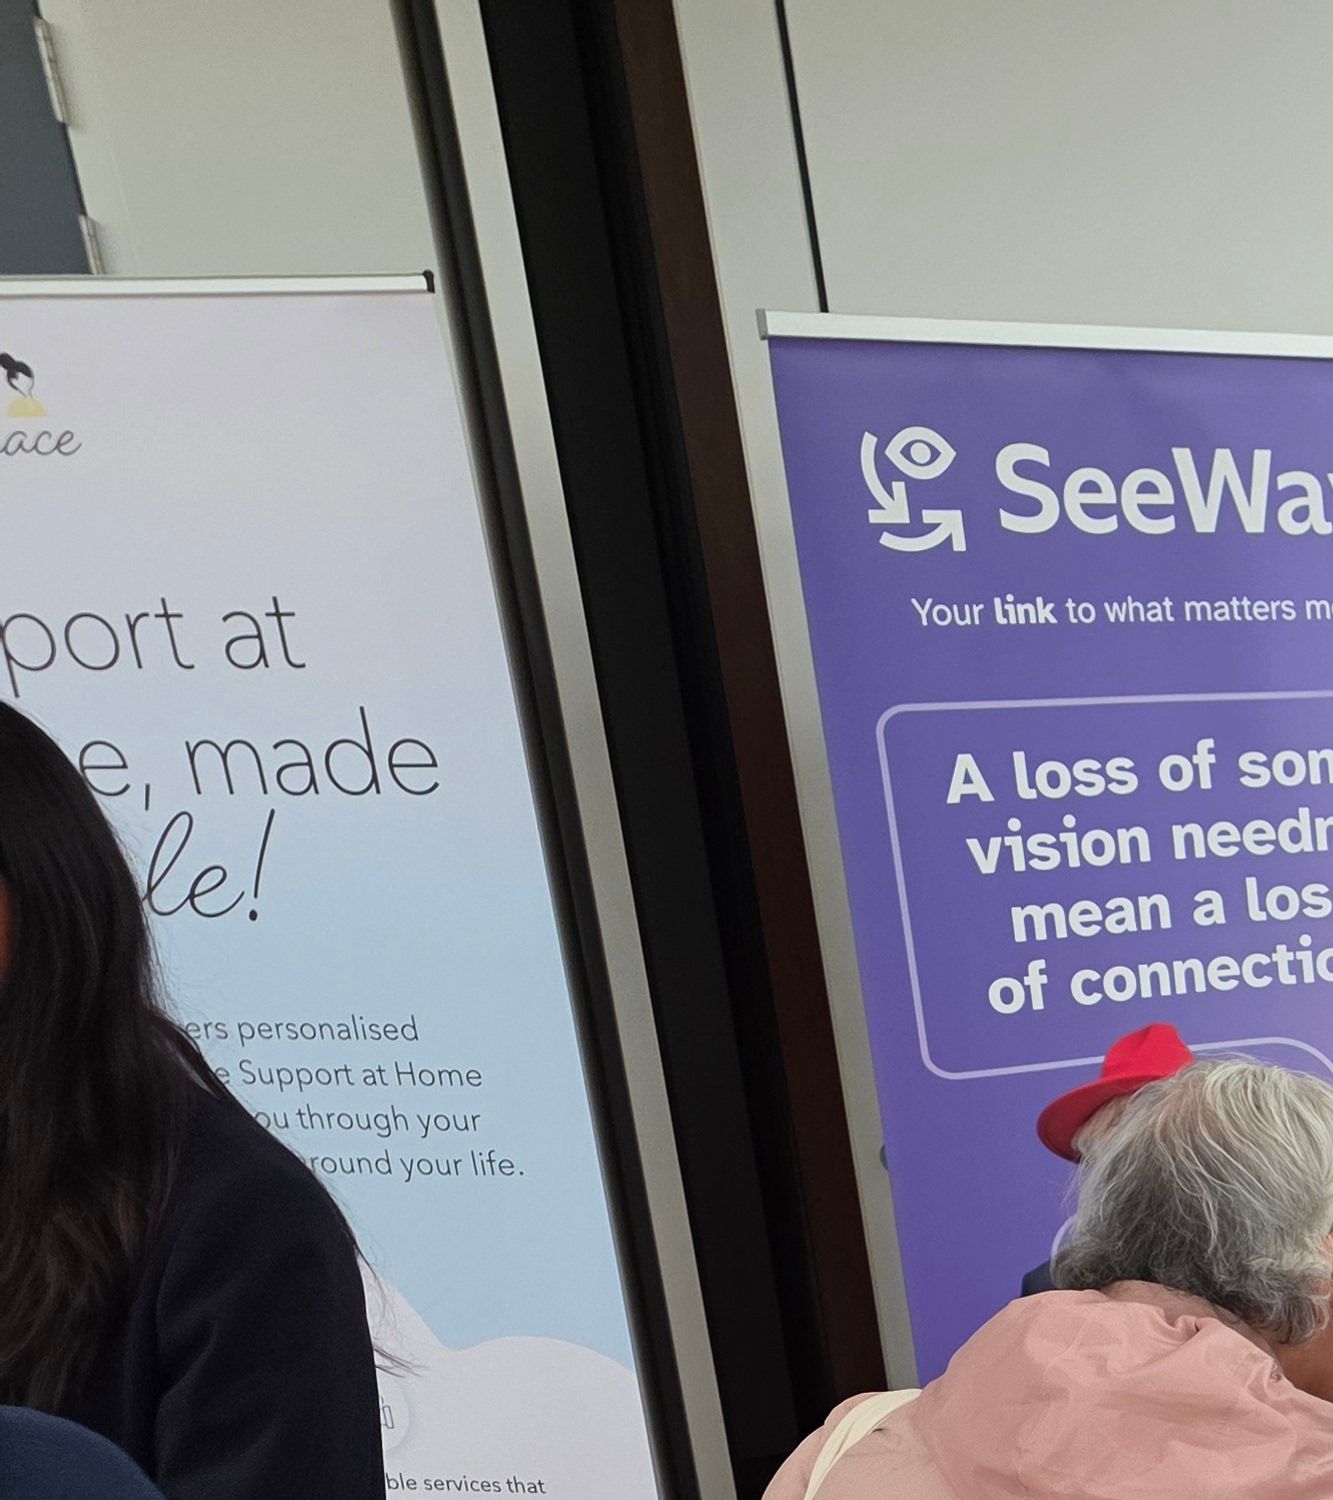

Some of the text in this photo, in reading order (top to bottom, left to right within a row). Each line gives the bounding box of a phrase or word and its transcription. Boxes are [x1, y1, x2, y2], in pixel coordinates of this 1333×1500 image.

[911, 597, 984, 628] Your
[994, 593, 1057, 625] link
[1067, 598, 1096, 624] to
[1104, 596, 1174, 624] what
[1184, 596, 1296, 622] matters
[0, 596, 306, 699] port at
[185, 705, 440, 797] made
[947, 753, 994, 804] A
[1013, 750, 1138, 799] loss
[1158, 738, 1216, 791] of
[966, 814, 1151, 875] vision
[1010, 888, 1172, 942] mean
[1193, 890, 1225, 925] a
[988, 962, 1048, 1014] of
[185, 1014, 420, 1048] ers personalised
[238, 1059, 356, 1093] Support
[362, 1064, 389, 1087] at
[394, 1061, 483, 1088] Home
[255, 1103, 481, 1139] ou through your
[309, 1149, 525, 1183] round your life.
[423, 1475, 502, 1494] services
[506, 1476, 547, 1495] that
